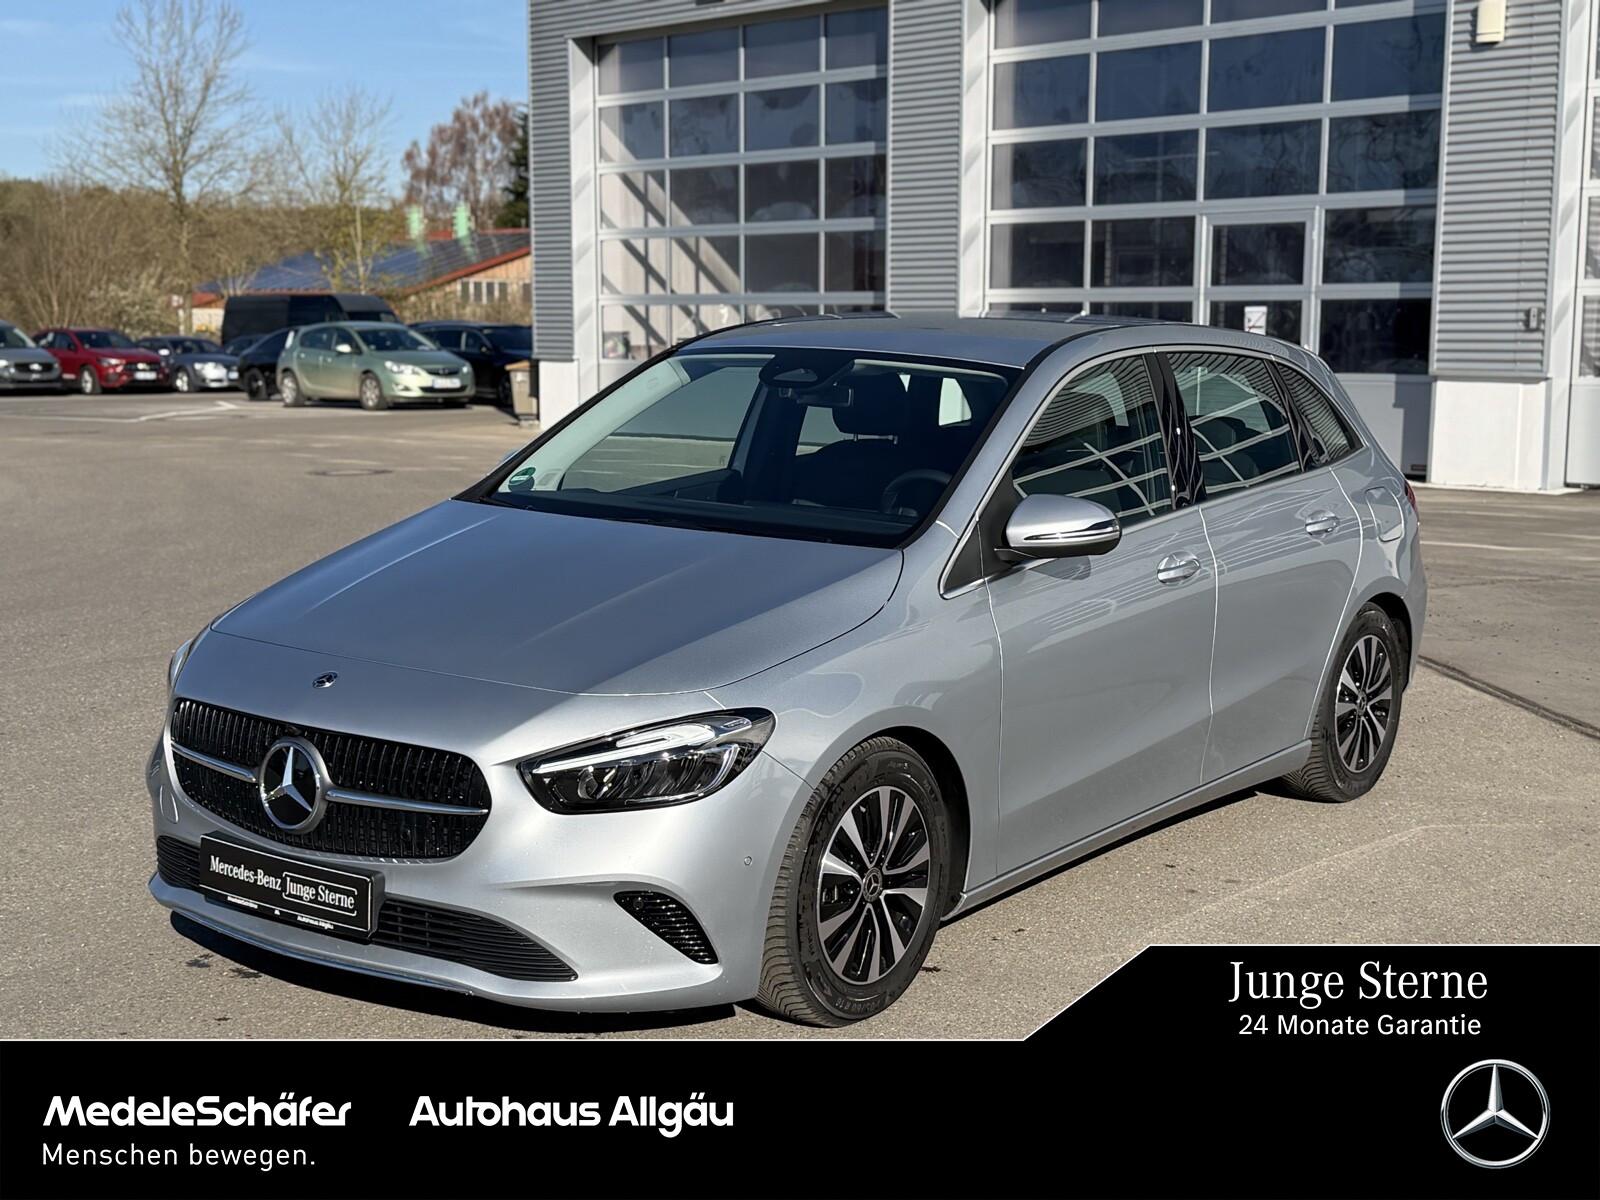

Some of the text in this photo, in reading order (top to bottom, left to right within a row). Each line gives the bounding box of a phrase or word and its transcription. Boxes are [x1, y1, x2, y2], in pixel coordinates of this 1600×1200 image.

[209, 855, 355, 909] Mercedes-Benz Junge Sterne
